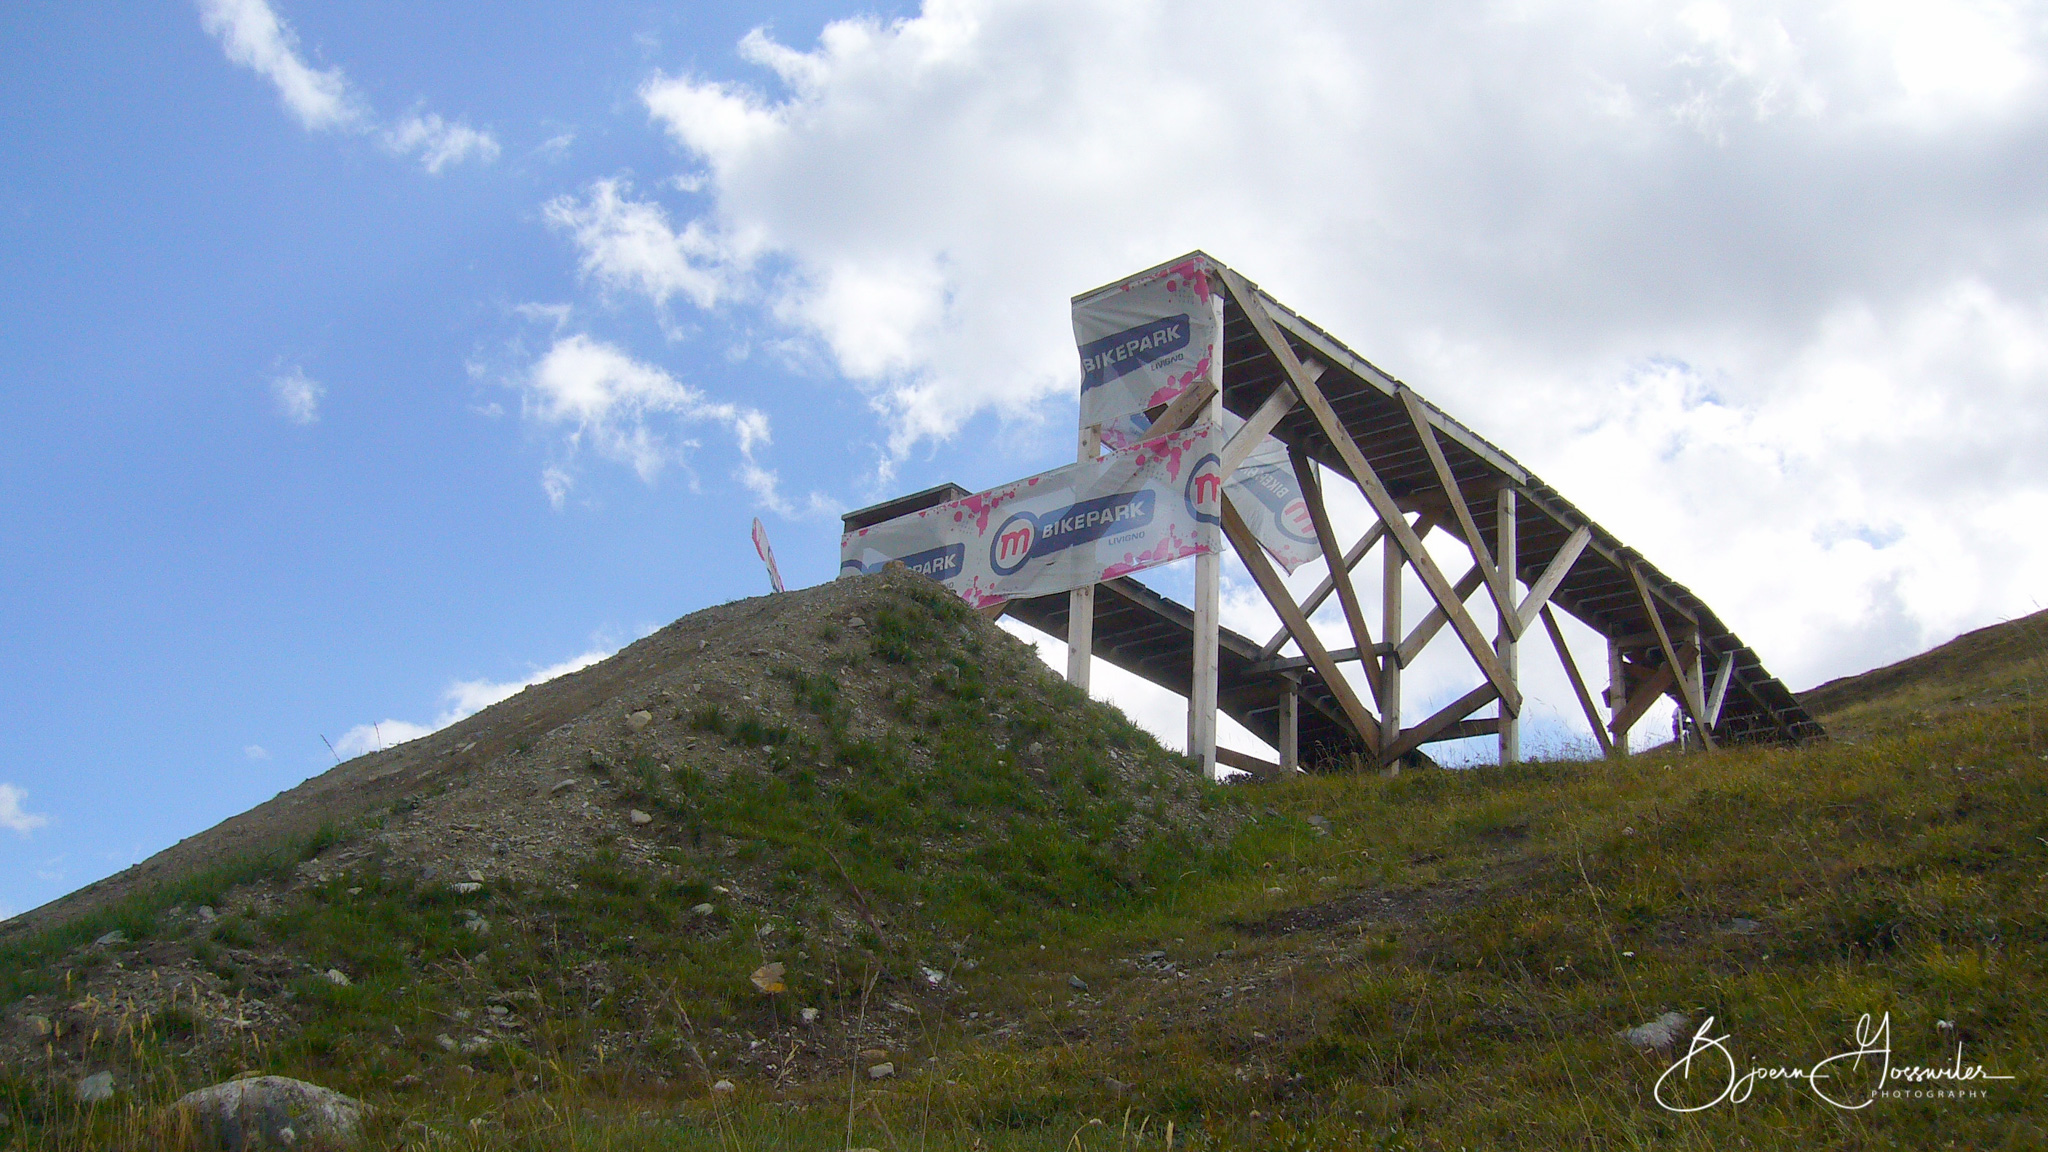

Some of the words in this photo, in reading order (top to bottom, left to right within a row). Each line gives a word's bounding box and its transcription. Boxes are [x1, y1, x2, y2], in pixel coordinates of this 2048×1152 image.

[1082, 324, 1181, 373] BIKEPARK
[1151, 353, 1184, 371] LIVIGNO
[1042, 500, 1146, 539] BIKEPARK
[1108, 531, 1146, 546] LIVIGNO
[909, 553, 956, 575] PARK
